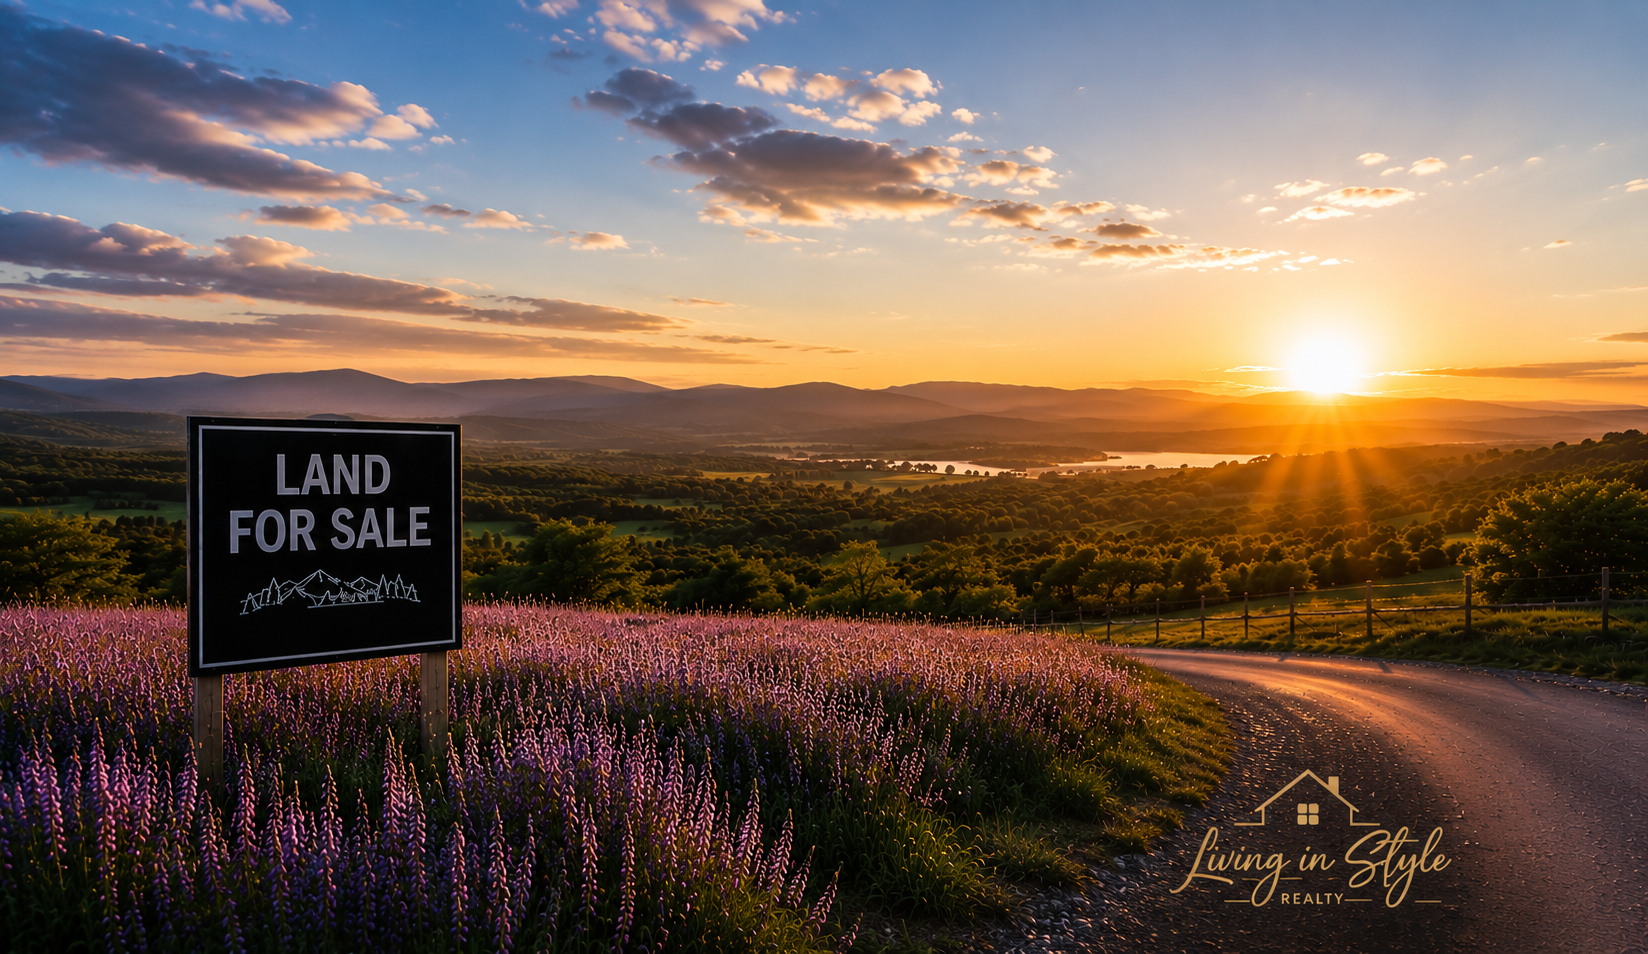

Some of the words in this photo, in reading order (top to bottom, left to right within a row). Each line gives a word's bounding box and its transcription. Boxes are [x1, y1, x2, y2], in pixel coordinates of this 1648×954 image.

[276, 453, 391, 496] LAND
[229, 508, 317, 554] FOR
[330, 506, 432, 550] SALE
